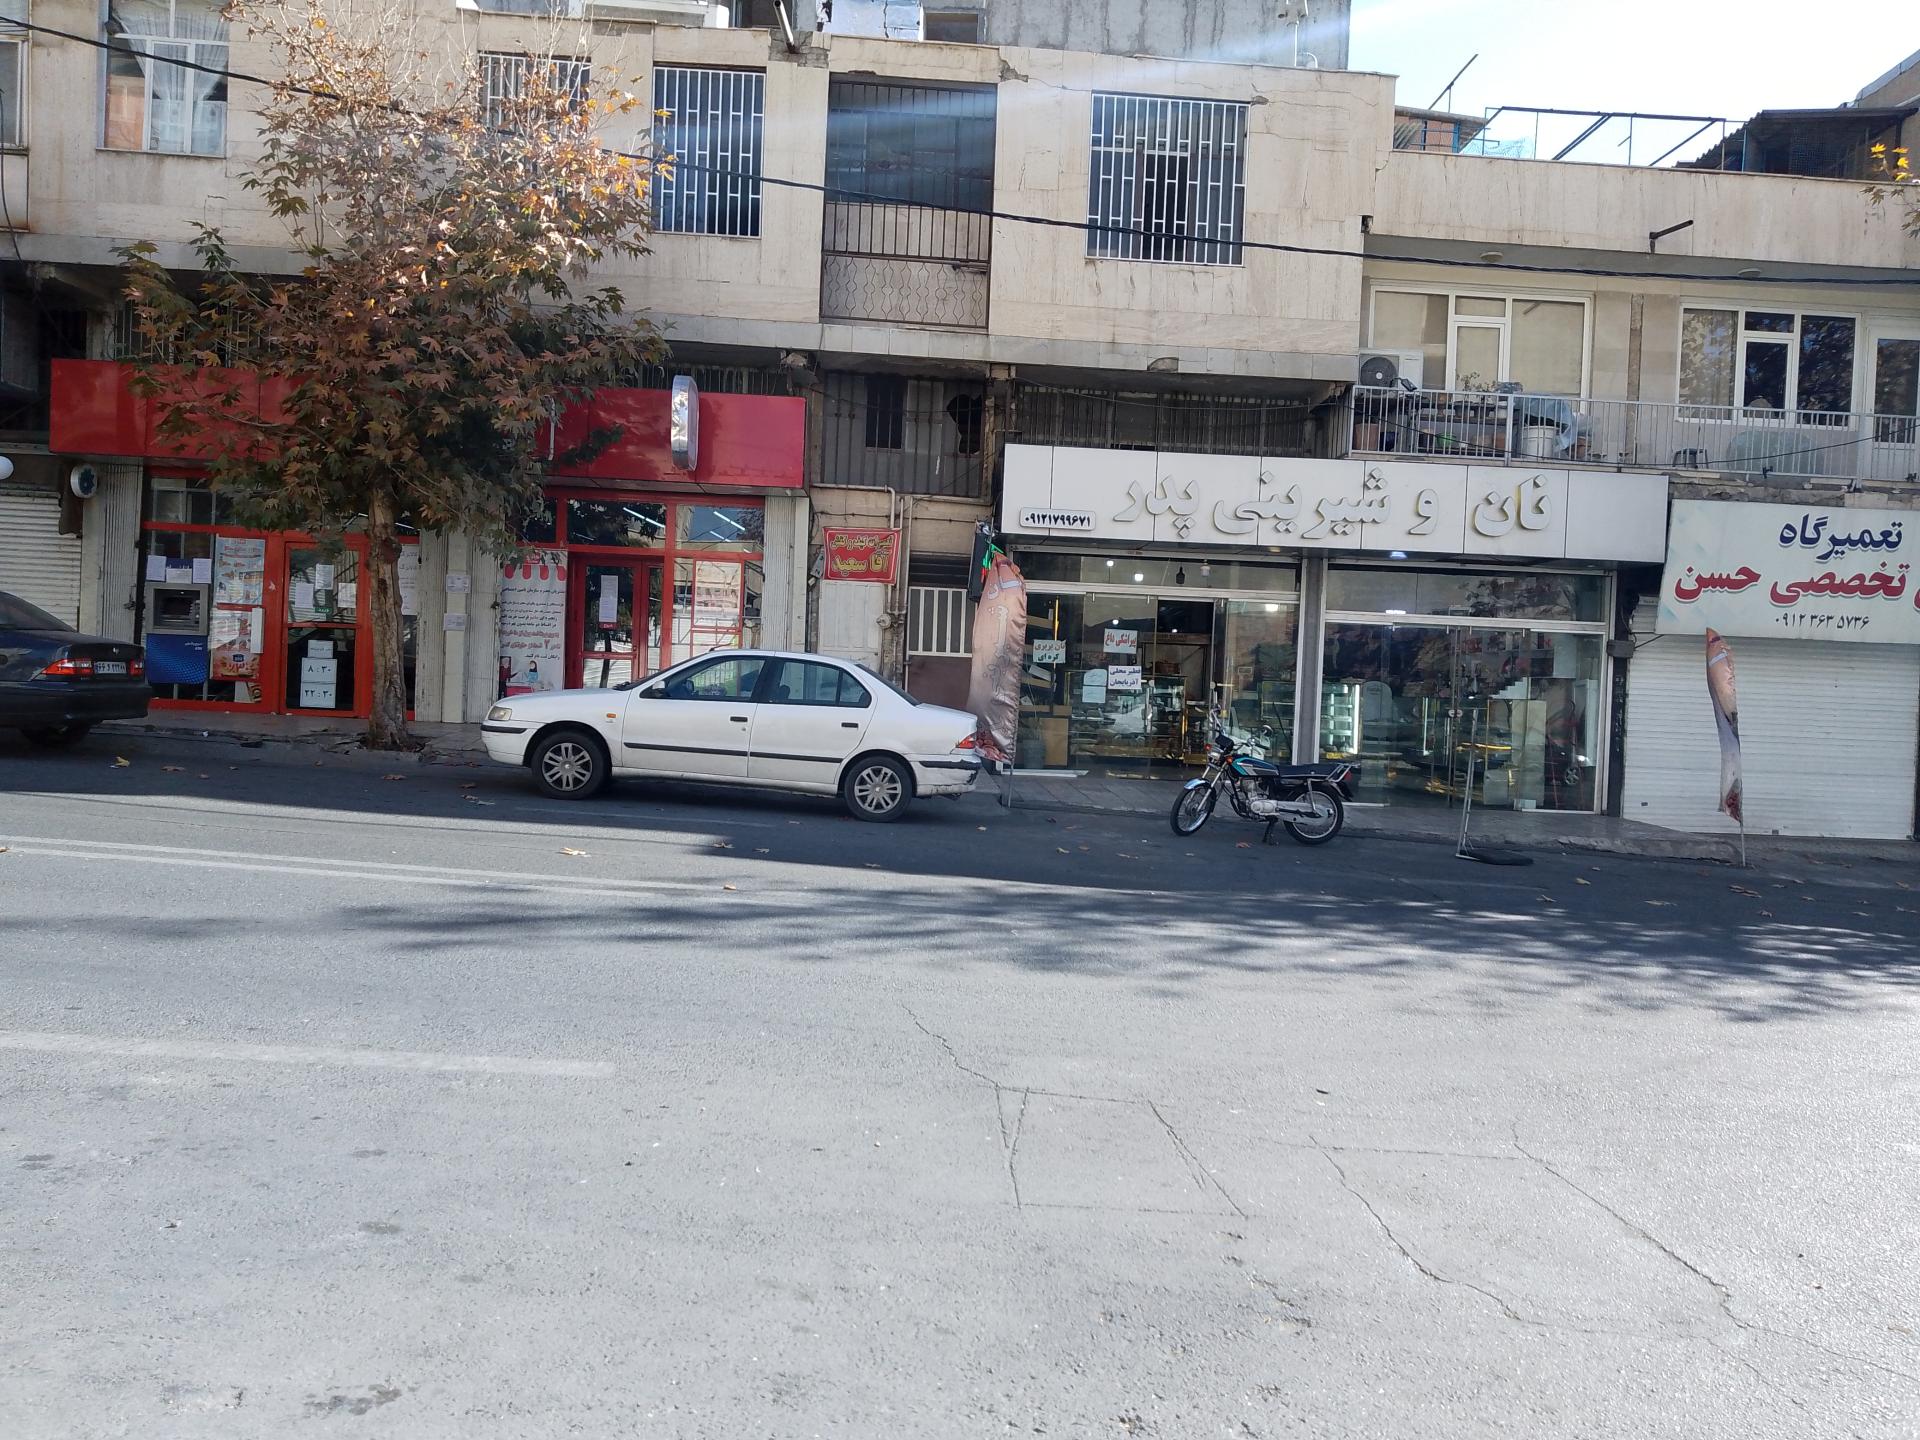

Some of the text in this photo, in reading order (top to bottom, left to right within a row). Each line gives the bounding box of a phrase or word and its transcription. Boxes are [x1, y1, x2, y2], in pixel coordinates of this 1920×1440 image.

[1025, 515, 1091, 530] ۰۹۱۲۱۷۹۹۶۷۱
[1113, 467, 1551, 539] نان و شیرینی پدر
[1779, 513, 1903, 561] تعمیرگاه
[1674, 565, 1762, 602] حسن
[1768, 561, 1911, 605] تخصصی
[1775, 613, 1805, 627] ۰۹۱۲
[1837, 615, 1870, 629] ۵۷۳۶
